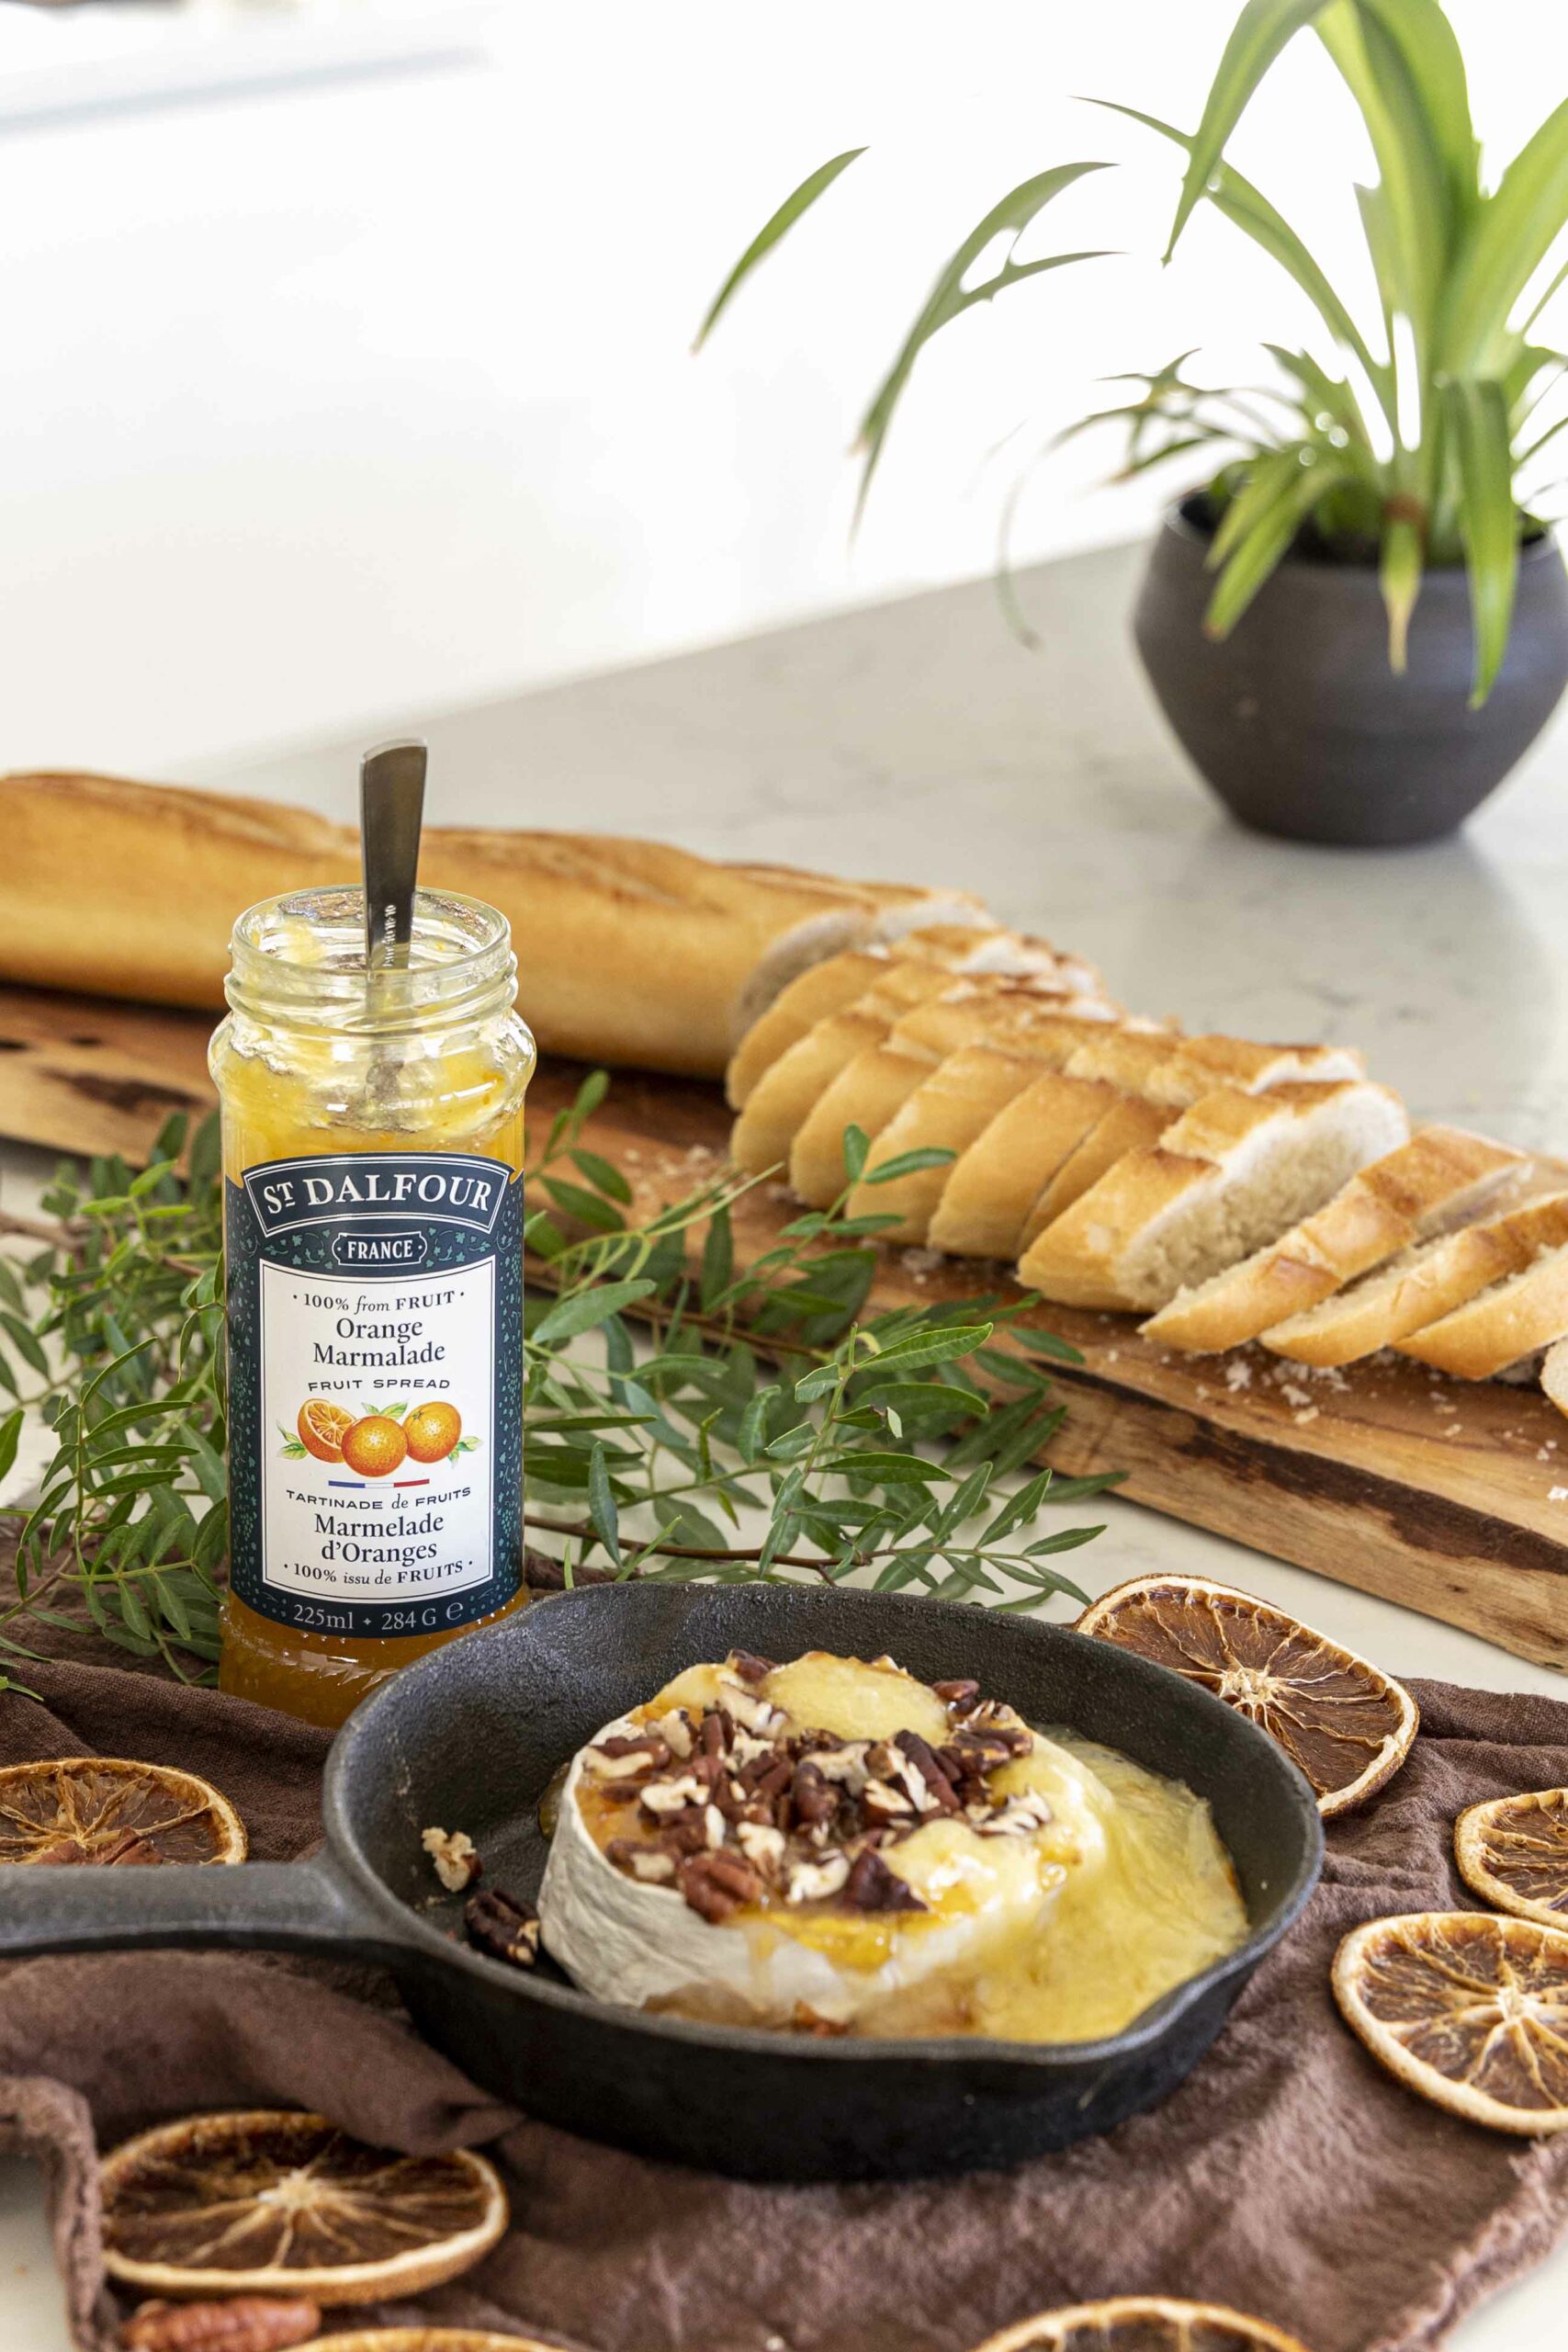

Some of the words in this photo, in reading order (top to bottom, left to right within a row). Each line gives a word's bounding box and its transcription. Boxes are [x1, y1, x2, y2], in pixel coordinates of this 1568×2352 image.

[302, 1173, 492, 1212] DALFOUR
[346, 1239, 413, 1260] FRANCE
[303, 1293, 349, 1312] 100%
[353, 1295, 390, 1316] from
[395, 1290, 456, 1312] FRUIT
[335, 1317, 423, 1343] Orange
[312, 1341, 446, 1368] Marmalade
[308, 1380, 363, 1392] FRUIT
[373, 1379, 450, 1389] SPREAD
[286, 1488, 384, 1510] TARTINADE
[391, 1493, 409, 1510] de
[414, 1487, 471, 1508] FRUITS
[313, 1512, 445, 1538] Marmelade
[321, 1541, 438, 1566] d'Oranges
[294, 1563, 337, 1583] 100%
[343, 1571, 370, 1585] issu
[375, 1569, 392, 1585] de
[397, 1560, 464, 1584] FRUITS
[292, 1604, 354, 1630] 225ml
[381, 1611, 417, 1631] 284
[422, 1608, 436, 1626] G
